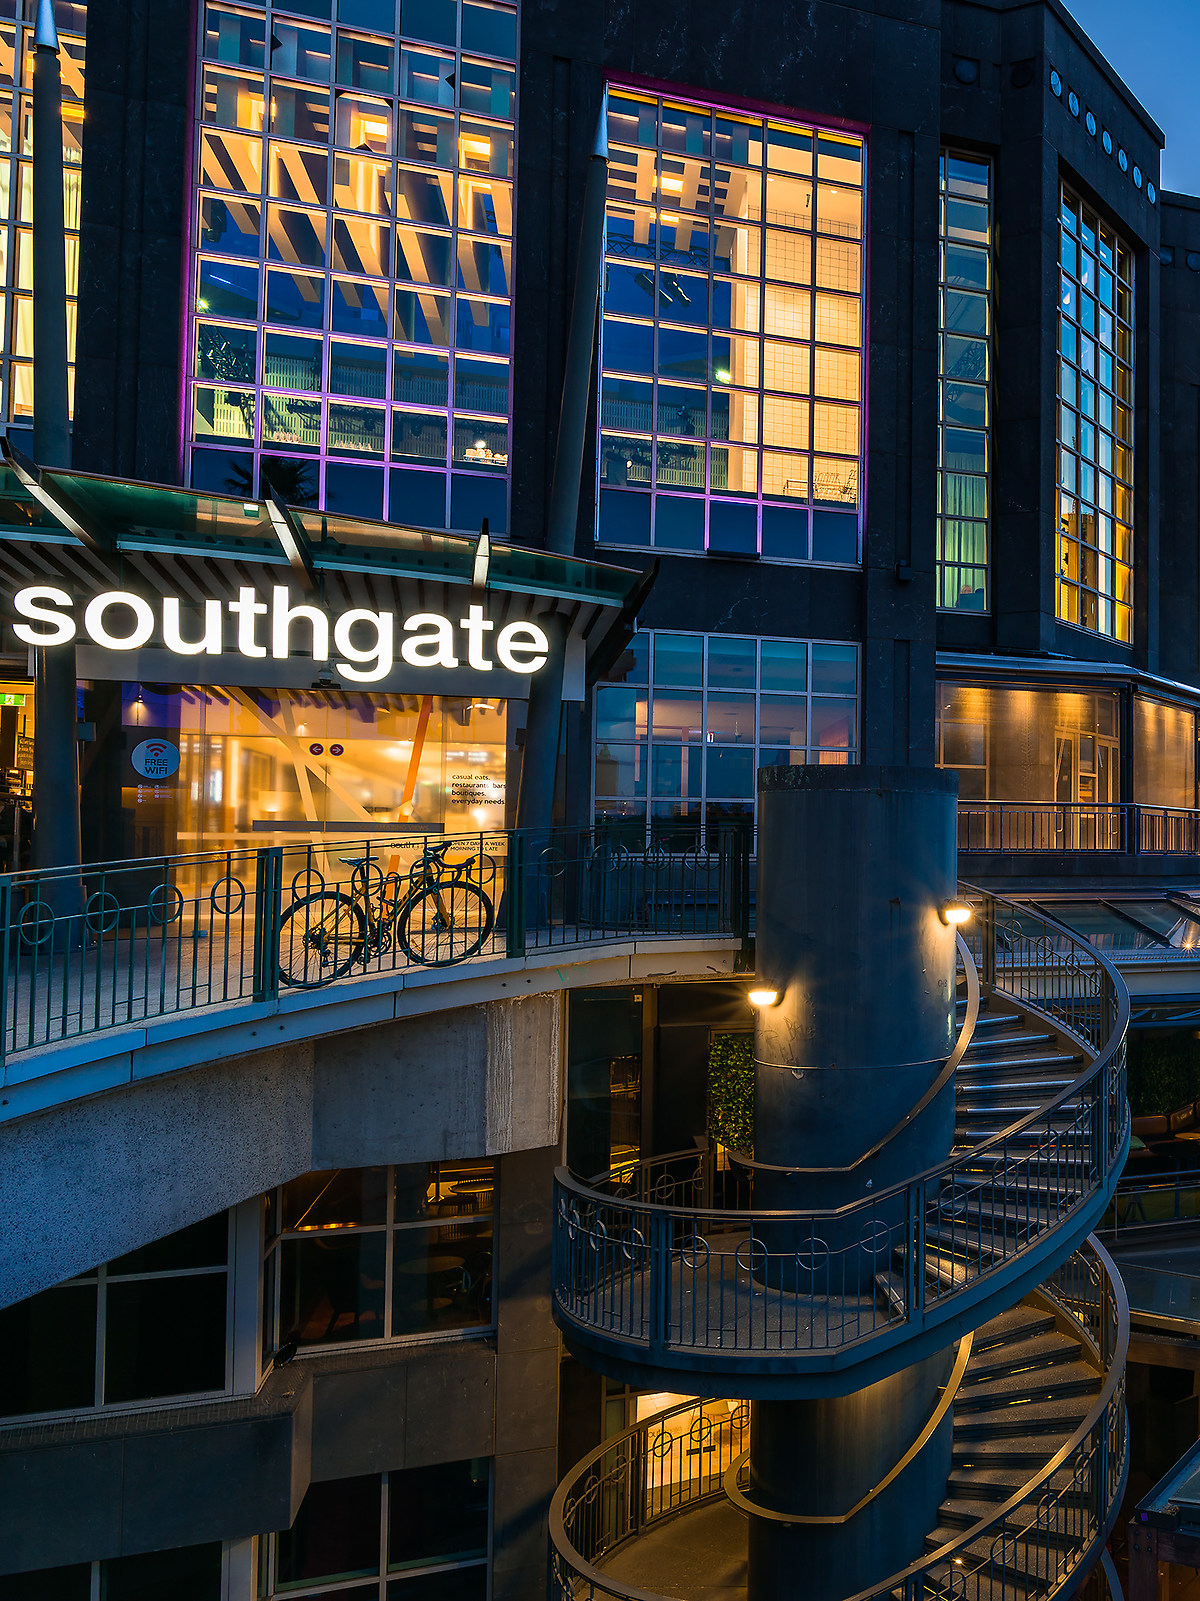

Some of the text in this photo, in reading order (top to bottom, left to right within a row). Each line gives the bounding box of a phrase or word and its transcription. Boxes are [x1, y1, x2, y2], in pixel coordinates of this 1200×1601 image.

[12, 586, 549, 682] southgate
[144, 758, 168, 766] FREE
[144, 766, 168, 775] WIFI
